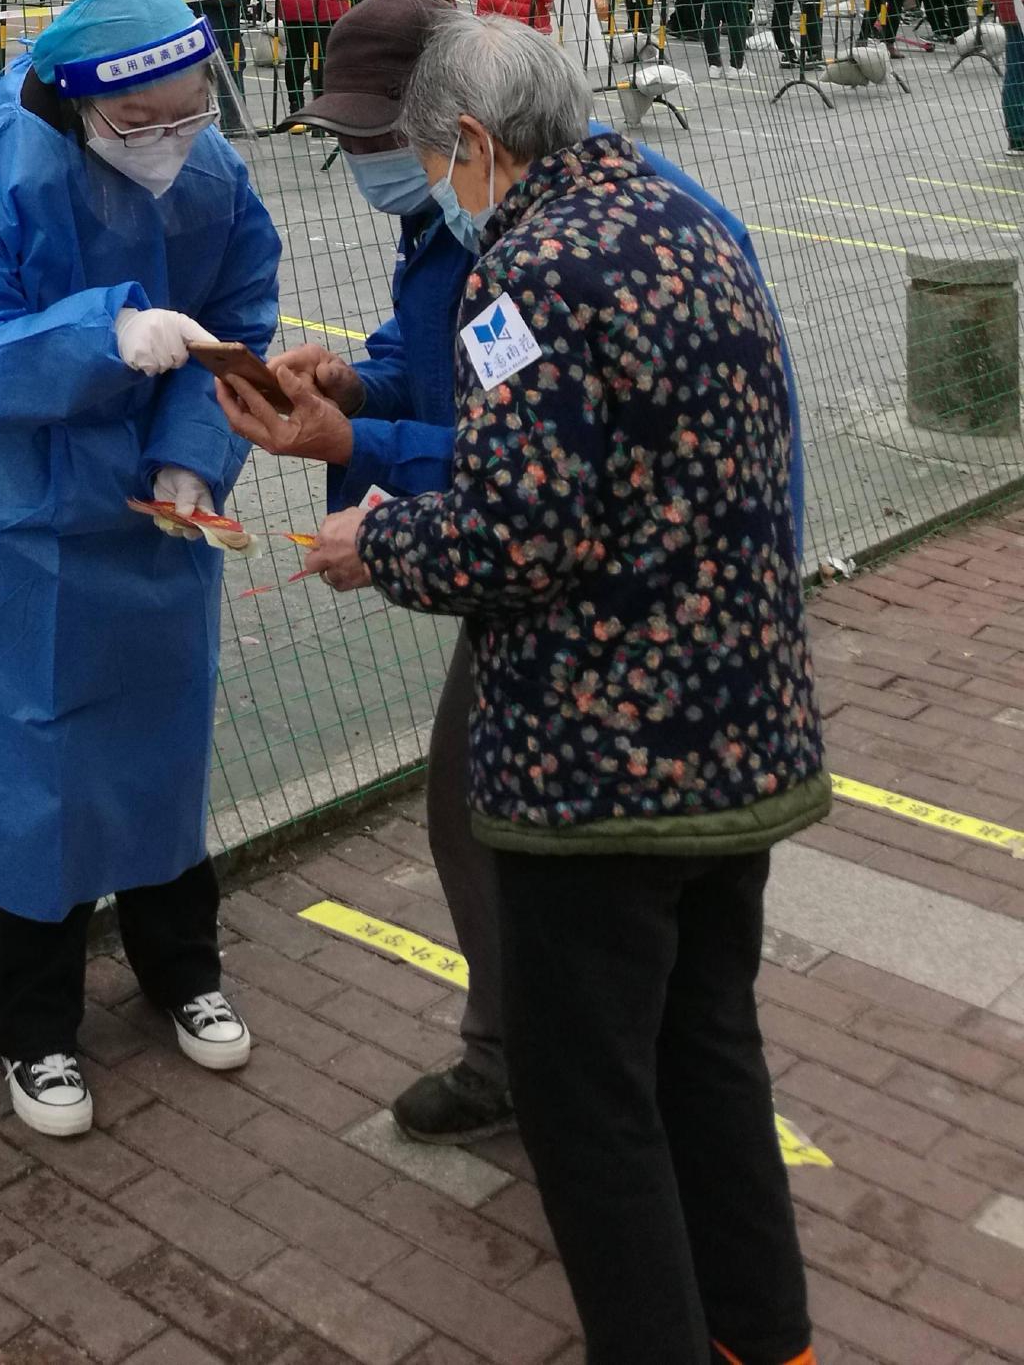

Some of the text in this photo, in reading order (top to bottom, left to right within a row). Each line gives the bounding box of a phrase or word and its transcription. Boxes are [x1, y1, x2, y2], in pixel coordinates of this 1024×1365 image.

[109, 36, 197, 77] 医用隔离面罩
